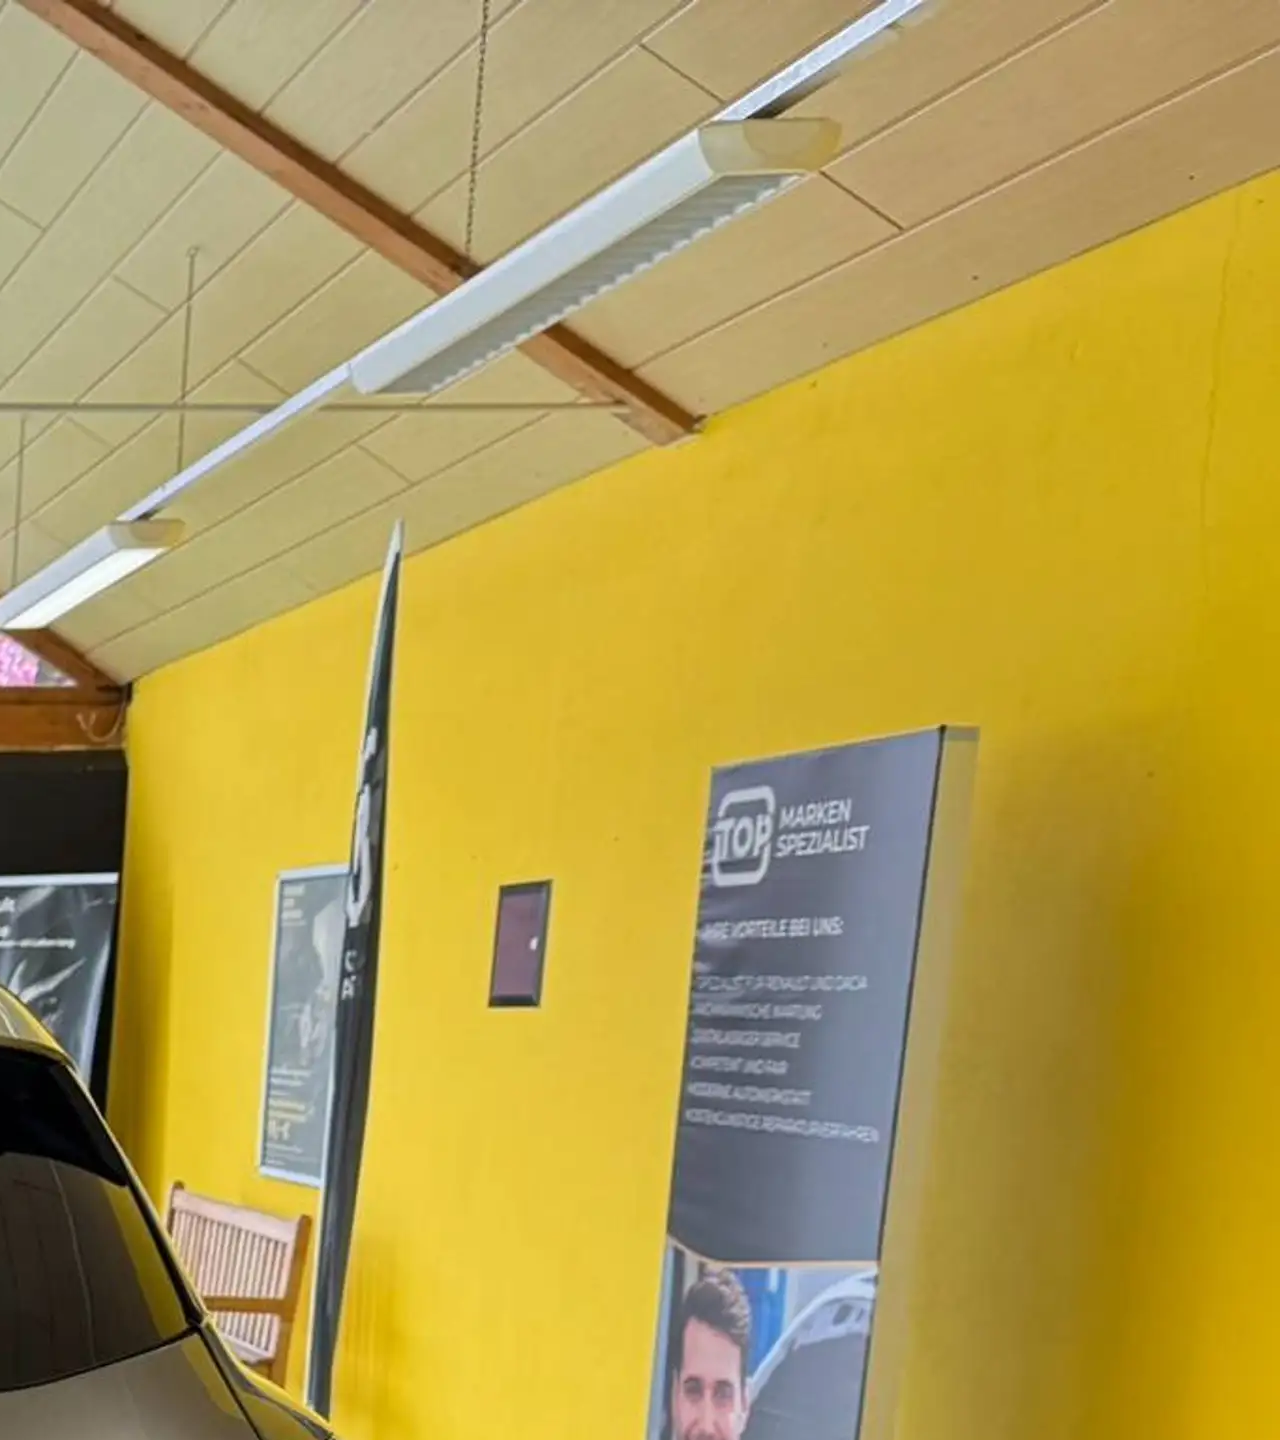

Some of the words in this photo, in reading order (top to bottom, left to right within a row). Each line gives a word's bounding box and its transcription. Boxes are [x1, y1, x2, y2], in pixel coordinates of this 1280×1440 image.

[778, 798, 853, 830] MARKEN
[713, 813, 774, 861] TOP
[773, 825, 871, 859] SPEZIALIST
[731, 919, 787, 940] VORTEILE
[788, 918, 810, 938] BEI
